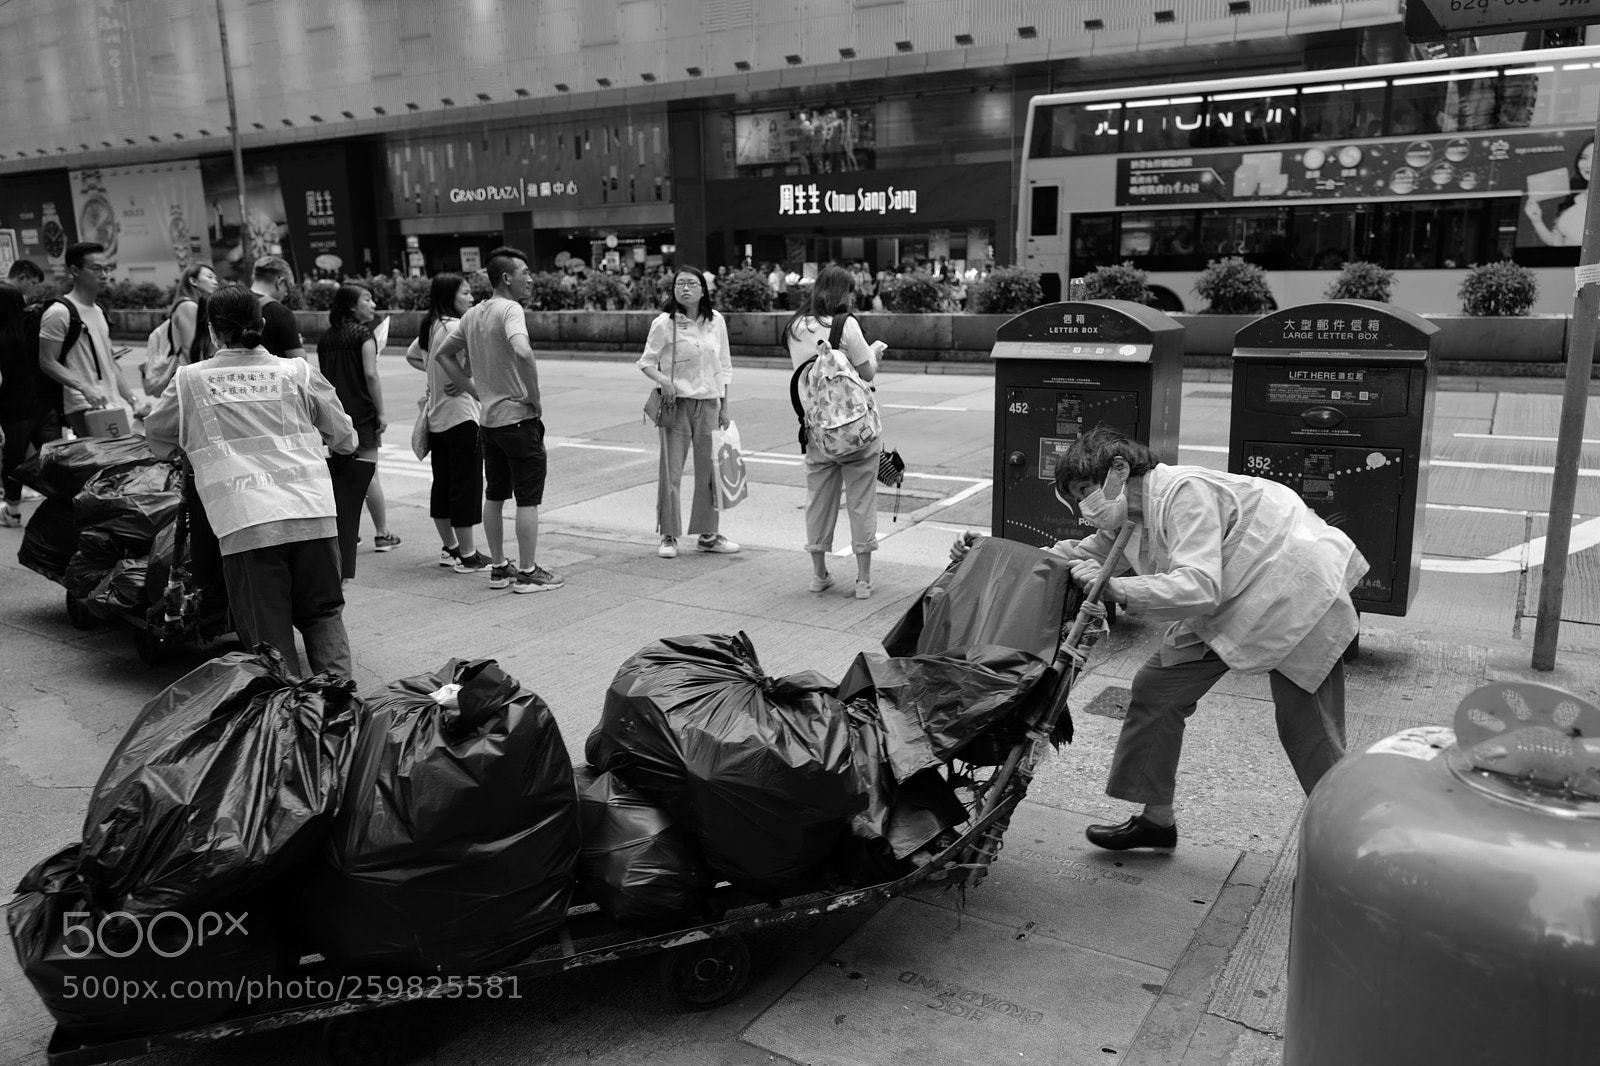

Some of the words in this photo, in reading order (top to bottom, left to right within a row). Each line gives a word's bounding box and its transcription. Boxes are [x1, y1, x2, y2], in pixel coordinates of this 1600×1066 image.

[449, 187, 487, 203] GRAND
[486, 185, 520, 200] PLAZA
[779, 183, 821, 215] 周生生
[824, 190, 856, 213] Chow
[857, 187, 886, 215] Sang
[887, 185, 917, 214] Sang
[1063, 314, 1085, 324] 信箱
[1283, 318, 1380, 332] 大型郵件信箱
[1049, 326, 1079, 334] LETTER
[1317, 332, 1354, 340] LETTER
[1289, 371, 1308, 379] LIFT
[1310, 371, 1336, 380] HERE
[1008, 402, 1029, 414] 452
[1247, 456, 1271, 470] 352
[898, 971, 1044, 1024] BROADBAND
[922, 996, 987, 1022] HGC
